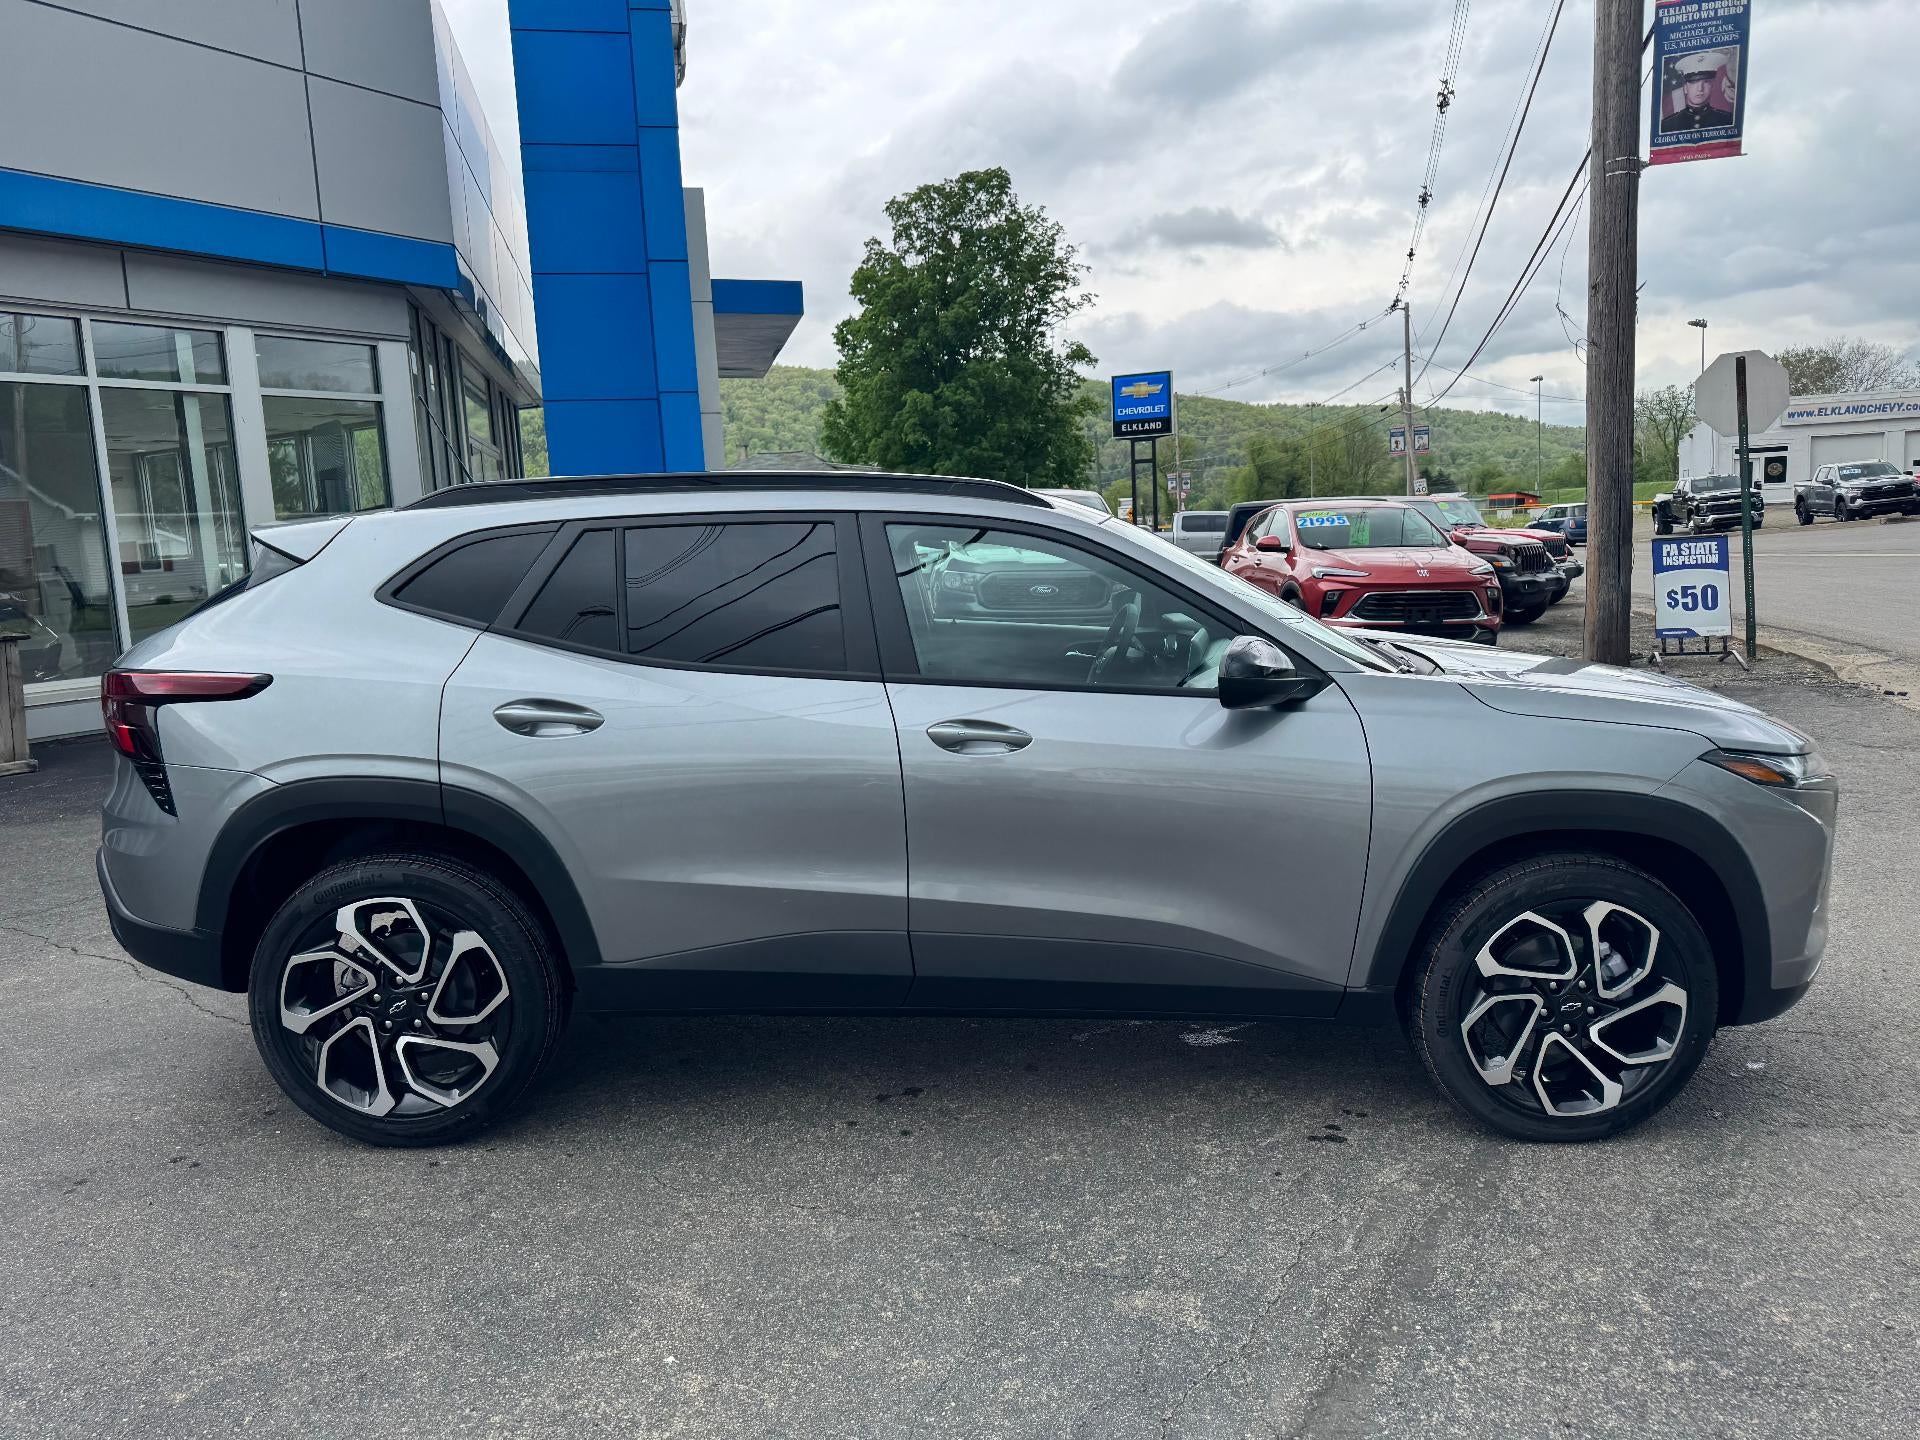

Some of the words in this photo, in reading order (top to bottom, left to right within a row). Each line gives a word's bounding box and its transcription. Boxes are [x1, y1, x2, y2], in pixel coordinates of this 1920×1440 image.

[1658, 4, 1699, 17] ELKLAND
[1662, 9, 1715, 25] HOMETOWN
[1717, 6, 1744, 16] HERO
[1669, 29, 1706, 40] MICHAEL
[1707, 23, 1735, 34] PLANK
[1664, 42, 1678, 50] U.S.
[1680, 37, 1711, 48] MARINE
[1712, 33, 1740, 43] CORPS
[1654, 135, 1678, 144] GLOBAL
[1678, 133, 1692, 141] WAR
[1692, 132, 1701, 140] ON
[1117, 404, 1166, 416] CHEVROLET
[1787, 402, 1920, 419] www.ELKLANDCHEVY.co
[1121, 421, 1162, 432] ELKLAND
[1415, 486, 1427, 494] 40
[1298, 515, 1346, 527] 21995
[1662, 543, 1679, 556] PA
[1680, 541, 1718, 555] STATE
[1662, 554, 1719, 566] INSPECTION
[1666, 584, 1719, 611] $50
[313, 873, 376, 904] Continental
